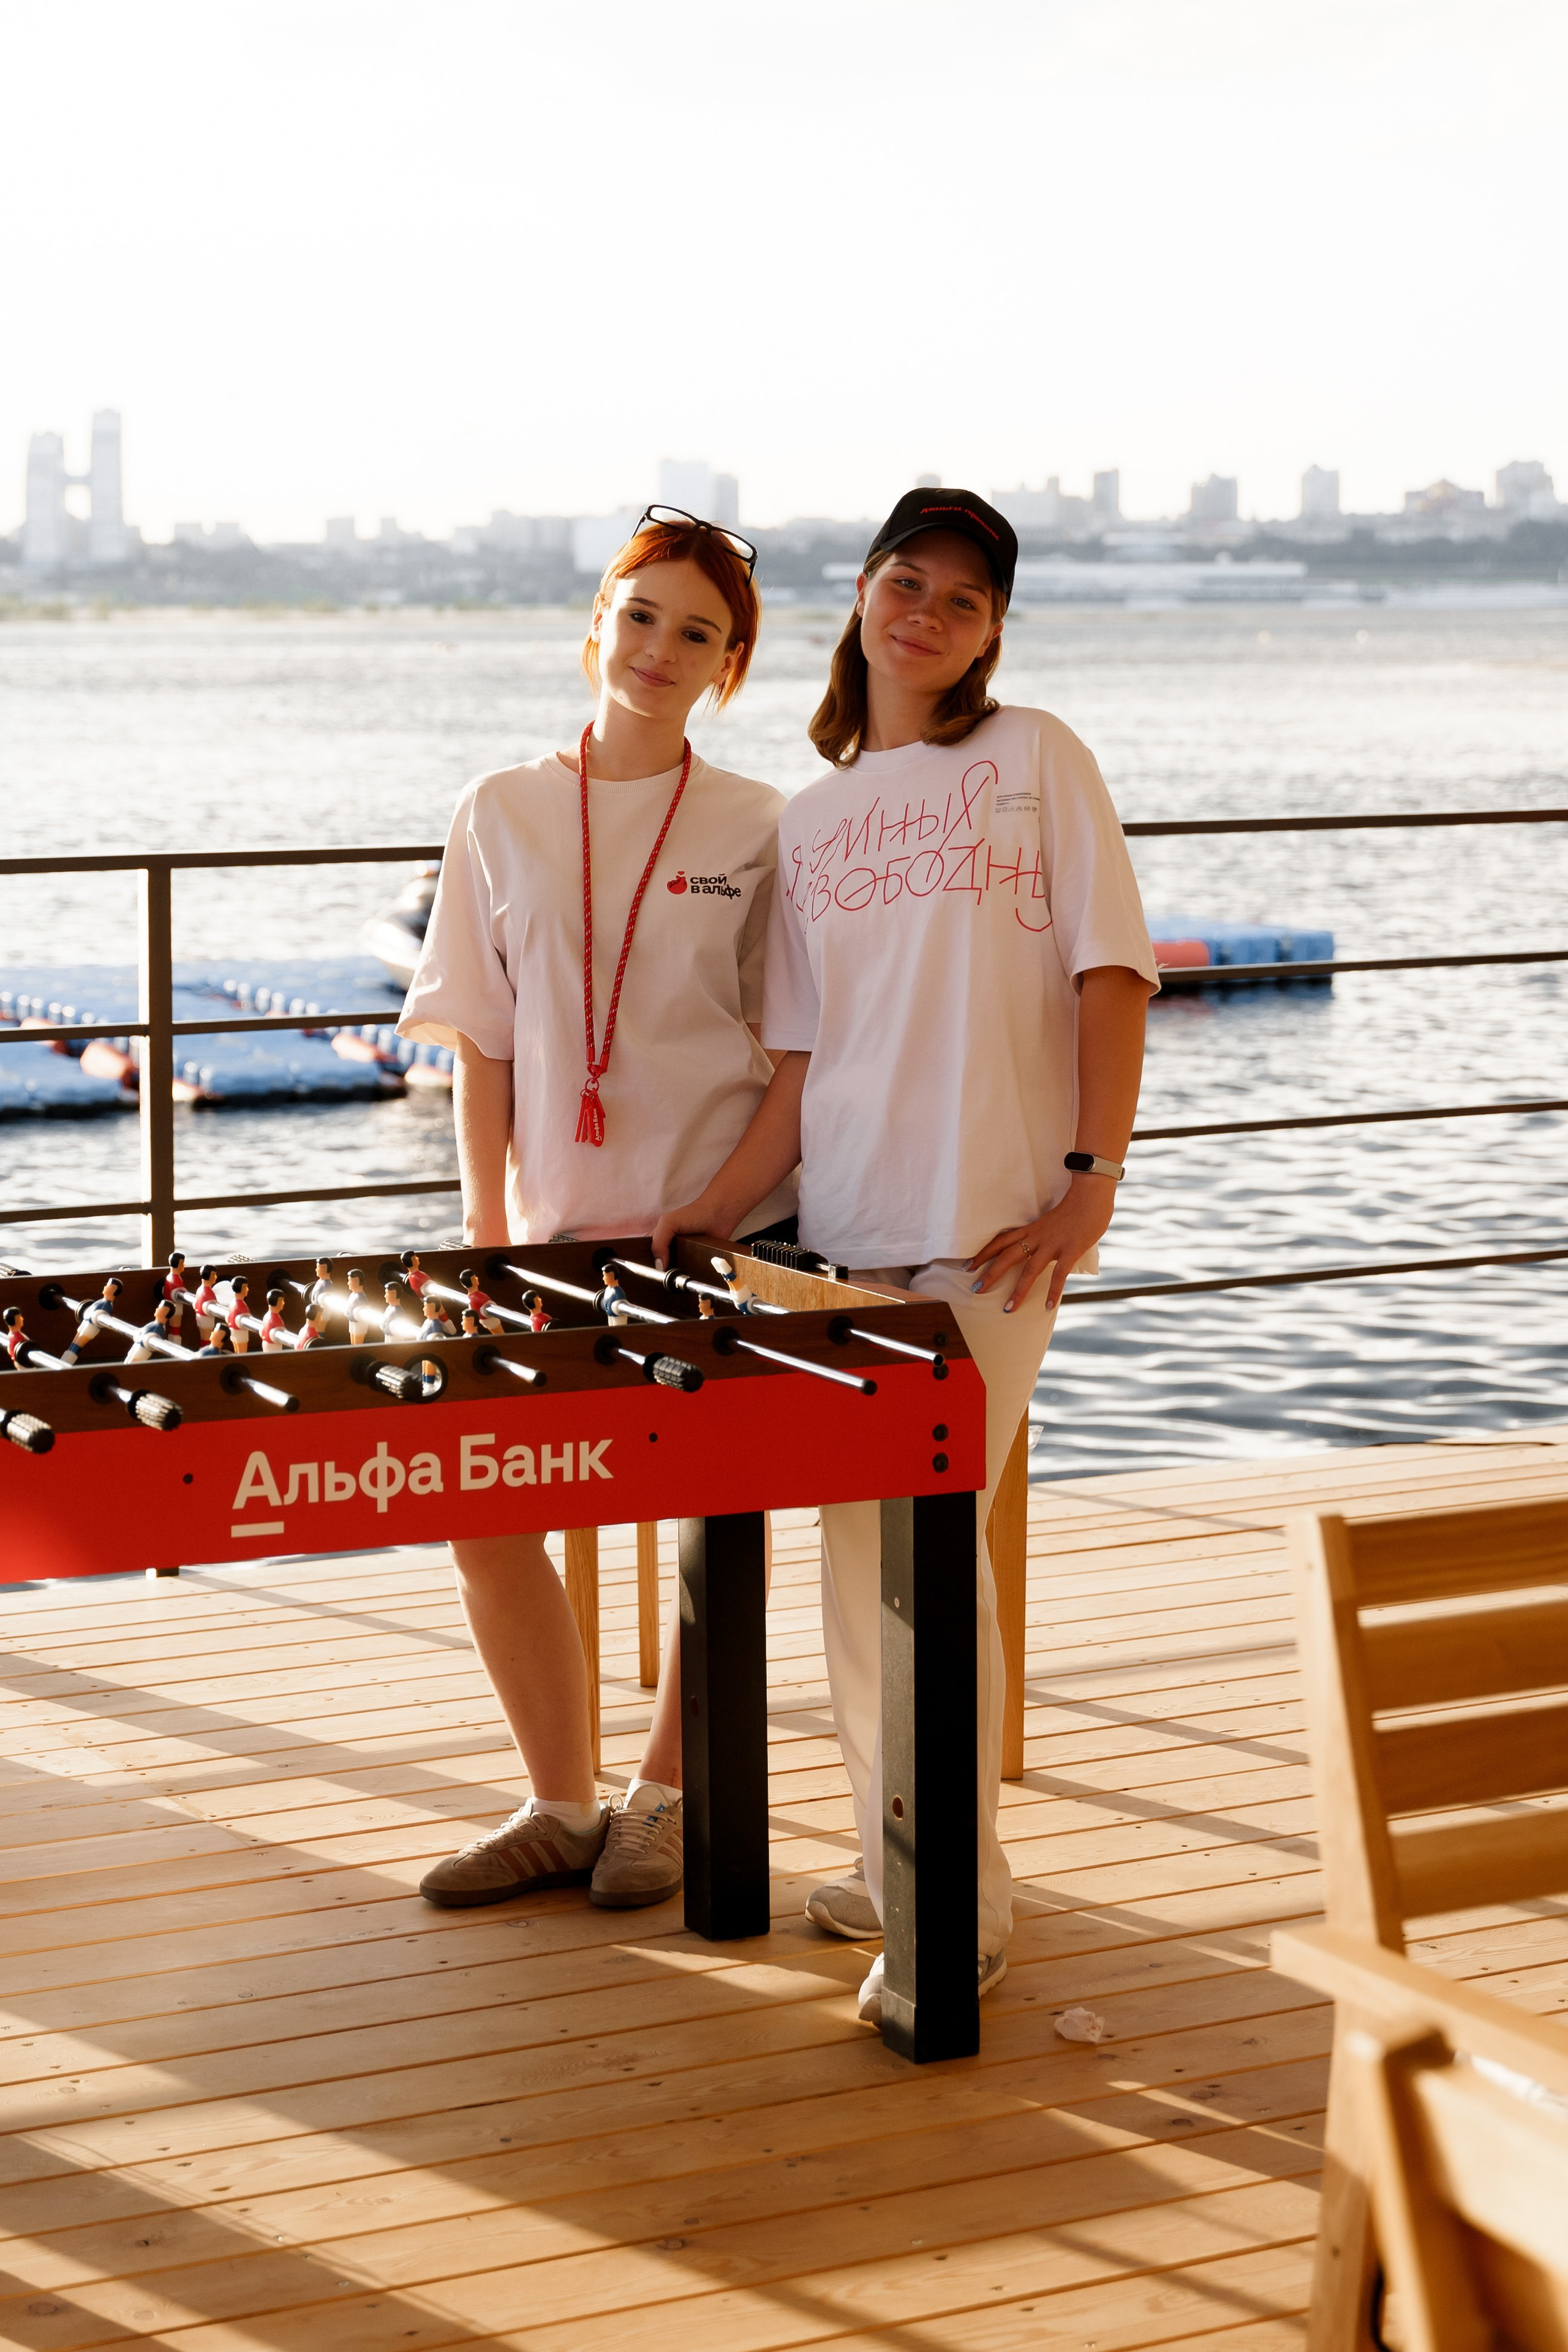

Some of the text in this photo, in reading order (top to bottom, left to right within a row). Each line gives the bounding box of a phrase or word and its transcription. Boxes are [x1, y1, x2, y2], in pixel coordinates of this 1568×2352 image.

[690, 873, 727, 885] свой
[702, 884, 742, 900] альфе
[231, 1433, 614, 1538] Альфа Банк
